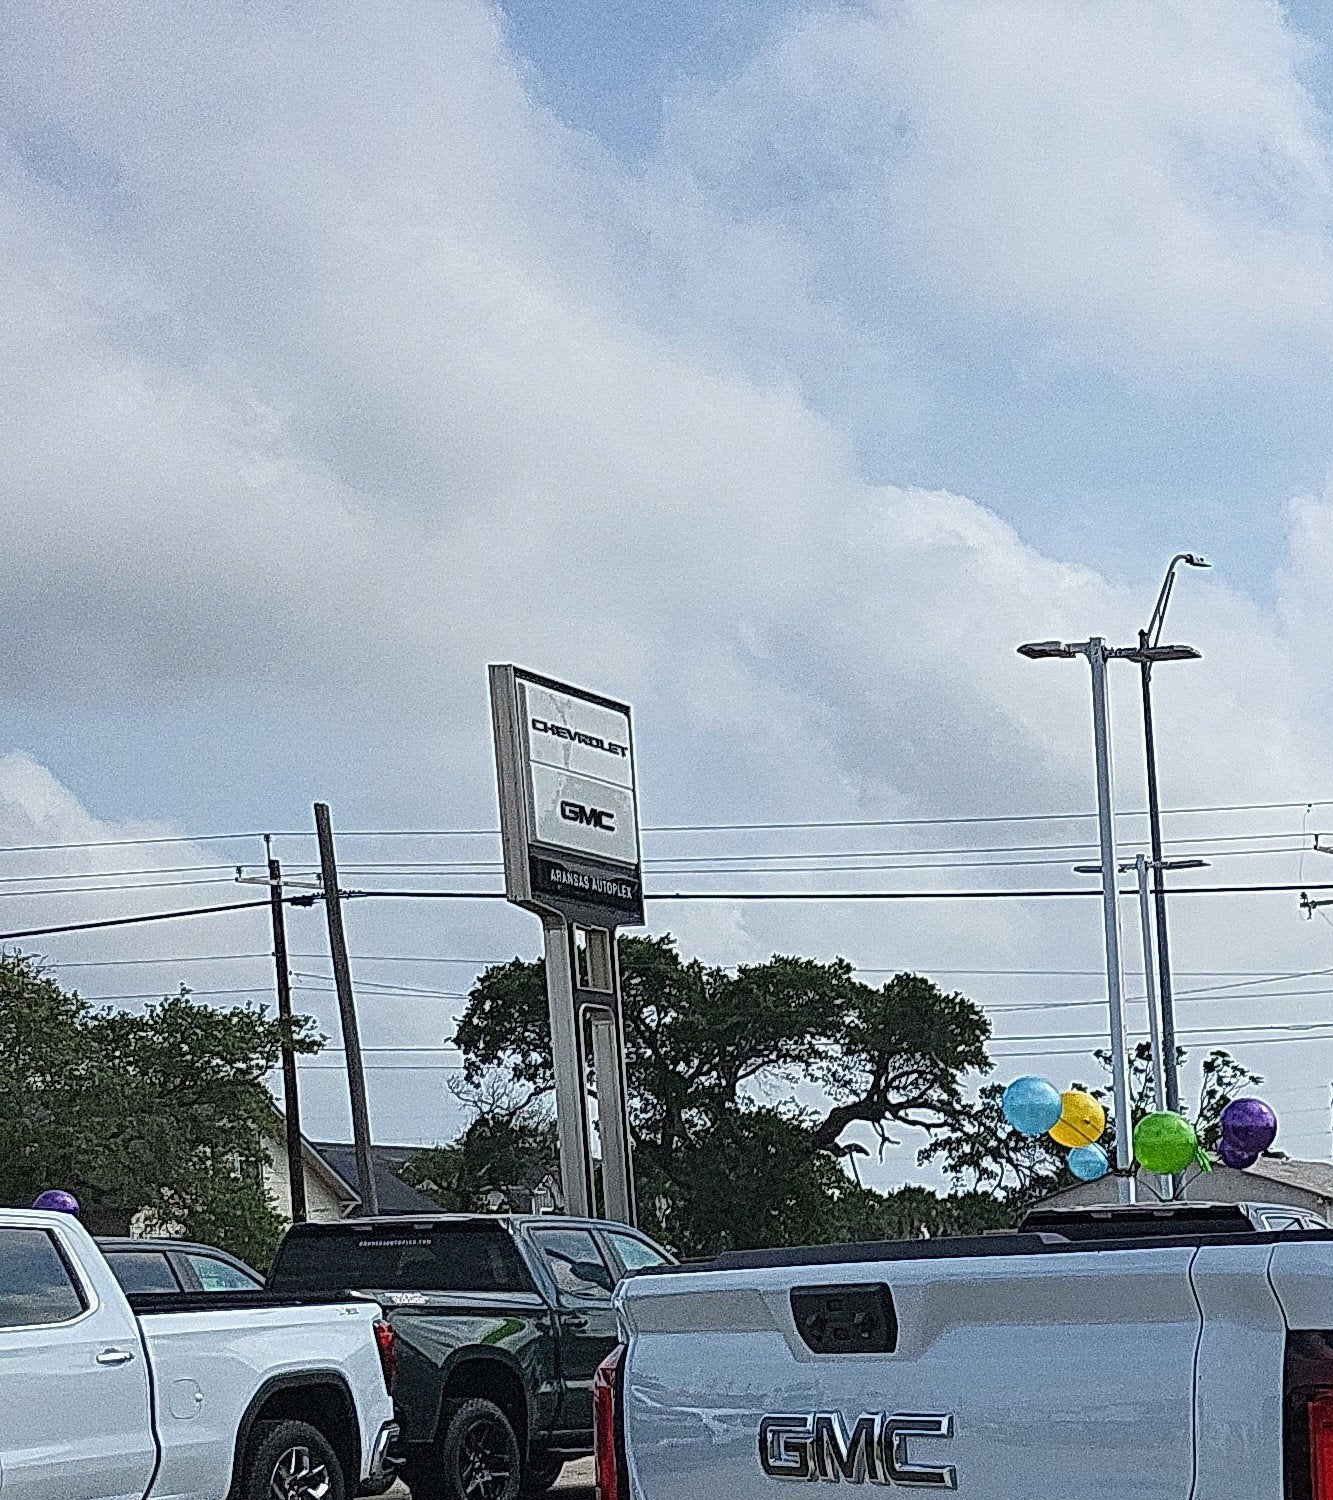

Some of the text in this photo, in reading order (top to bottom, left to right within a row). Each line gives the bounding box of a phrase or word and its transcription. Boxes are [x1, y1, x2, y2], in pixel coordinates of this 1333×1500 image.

[531, 718, 629, 758] CHEVROLET
[560, 800, 616, 832] GMC
[550, 868, 633, 899] ARANSAS AUTOPLEX
[758, 1410, 958, 1491] GMC
